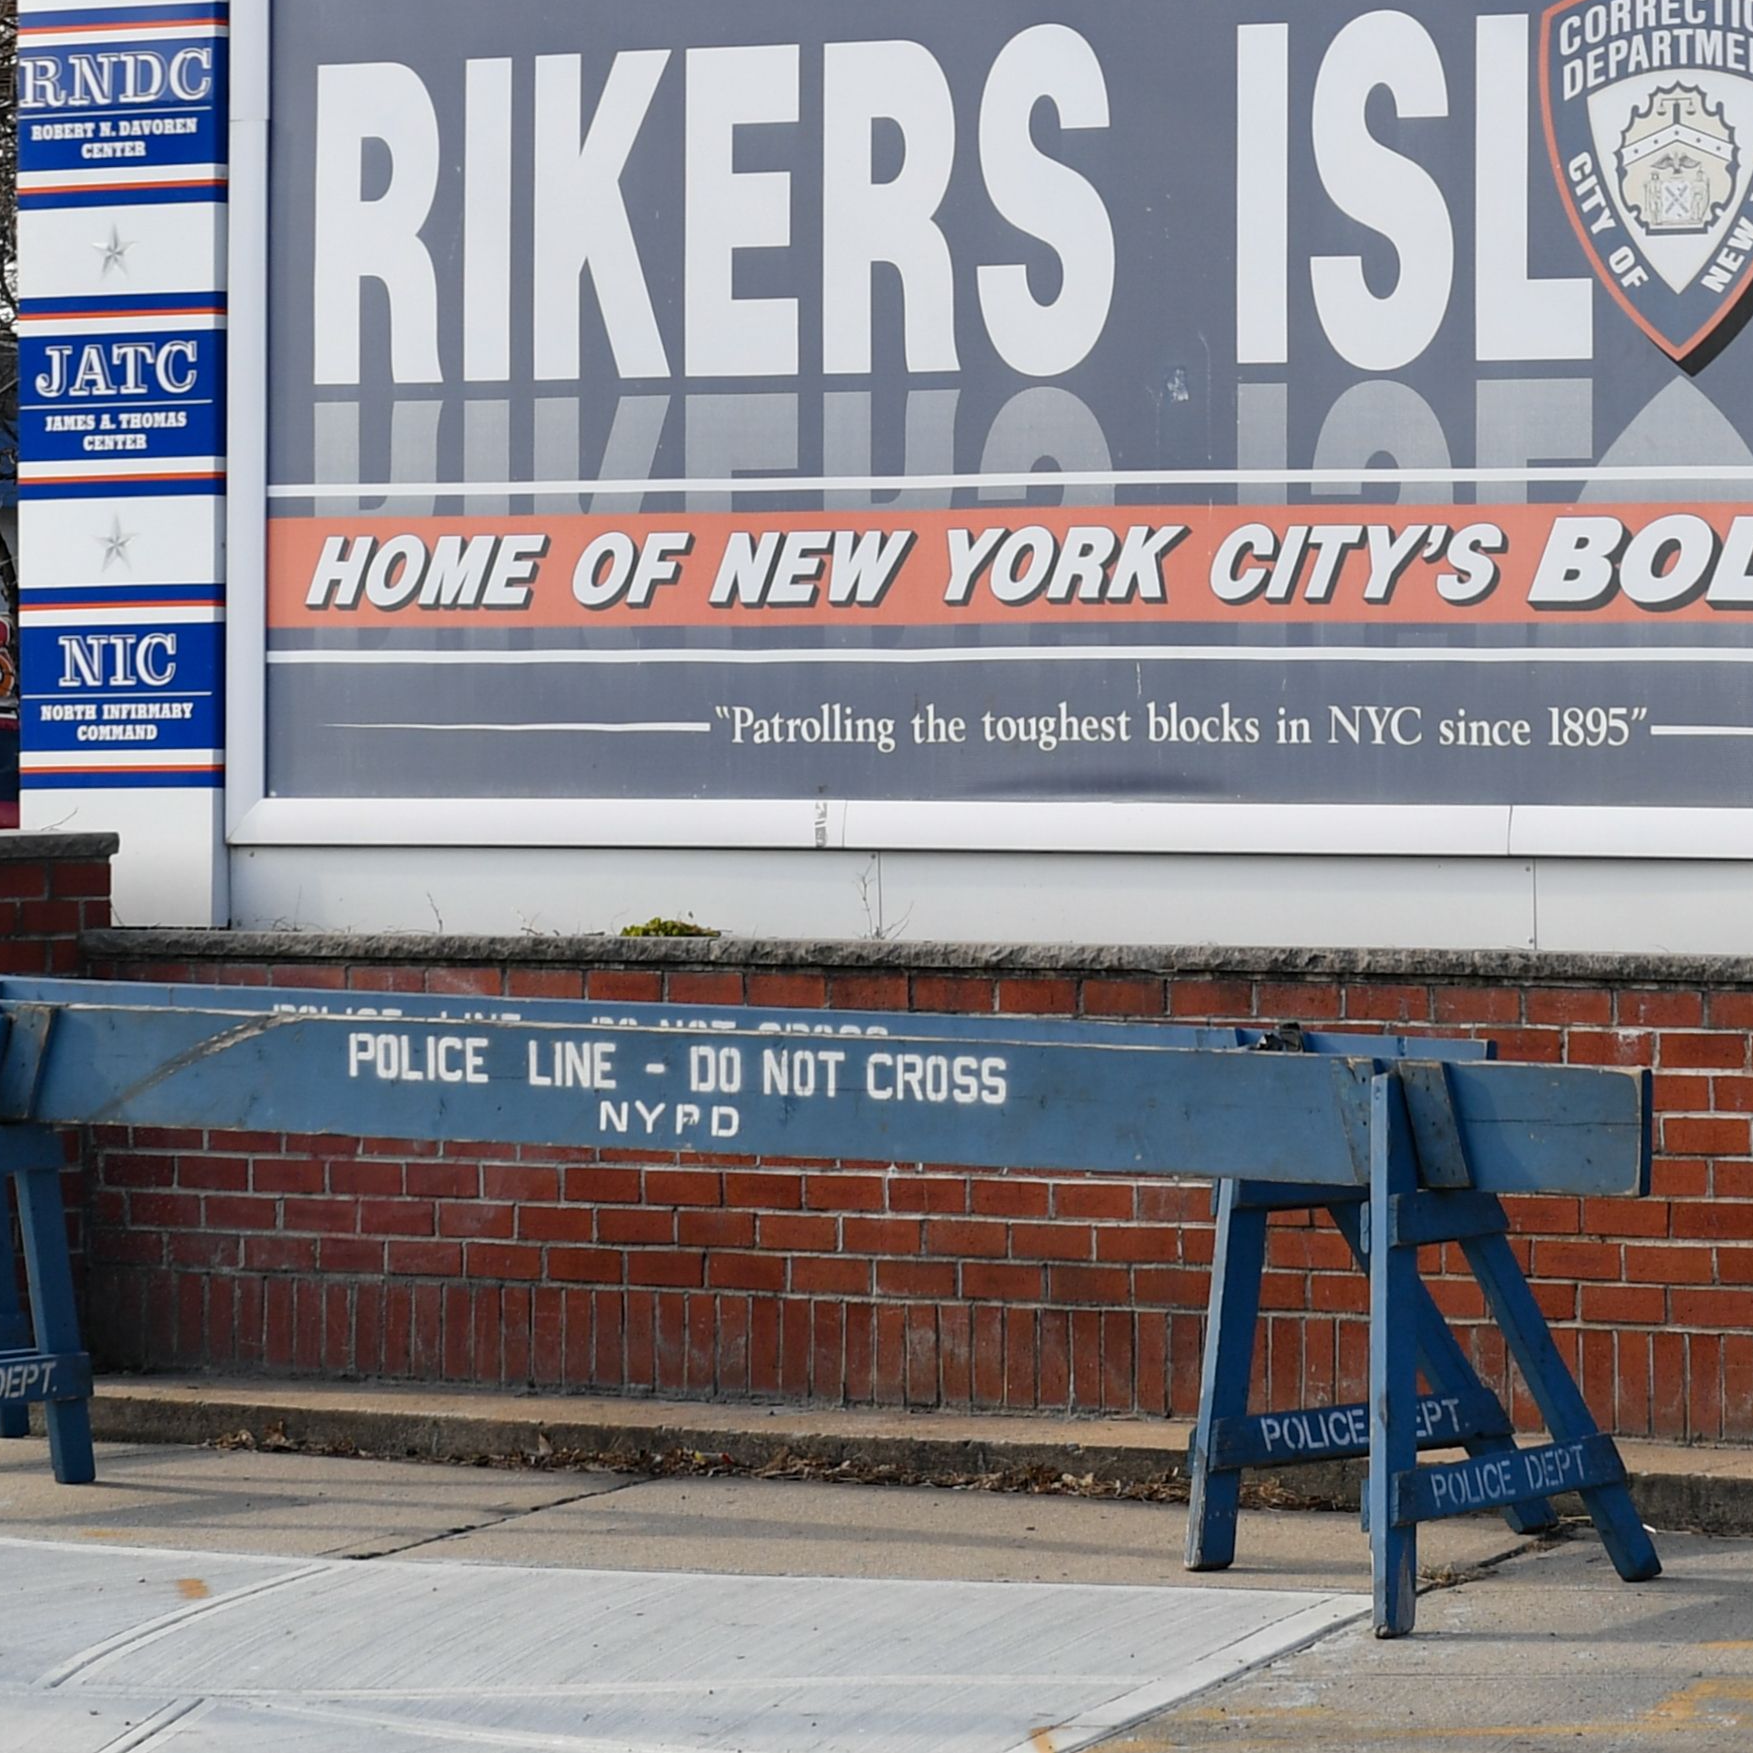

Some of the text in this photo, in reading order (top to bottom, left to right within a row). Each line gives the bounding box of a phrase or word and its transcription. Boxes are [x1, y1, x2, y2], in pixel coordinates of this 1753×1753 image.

[19, 47, 212, 109] RNDC
[31, 122, 96, 142] ROBERT
[118, 117, 197, 136] DAVOREN
[81, 140, 146, 159] CENTER
[313, 23, 1116, 385] RIKERS
[1568, 151, 1615, 236] CITY
[1608, 245, 1649, 289] OF
[35, 340, 198, 397] JATC
[45, 411, 187, 432] JAMES A. THOMAS
[83, 434, 147, 452] CENTER
[304, 534, 549, 611] HOME
[570, 531, 691, 610] OF
[708, 529, 918, 610] NEW
[942, 525, 1190, 608] YORK
[1211, 522, 1508, 607] CITY'S
[58, 632, 177, 688] NIC
[40, 703, 194, 721] NORTH INFIRMARY
[77, 724, 158, 742] COMMAND
[911, 703, 966, 744] the
[981, 701, 1131, 751] toughest
[1146, 701, 1260, 744] blocks
[1275, 706, 1312, 744] in
[1328, 705, 1423, 745] NYC
[1439, 708, 1531, 747] since
[348, 1032, 489, 1084] POLICE
[528, 1039, 618, 1090] LINE
[690, 1045, 742, 1093] DO
[762, 1048, 846, 1099] NOT
[866, 1052, 1008, 1105] CROSS
[599, 1100, 741, 1139] NYPD
[1260, 1398, 1471, 1453] POLICE EPT.
[1430, 1458, 1517, 1510] POLICE
